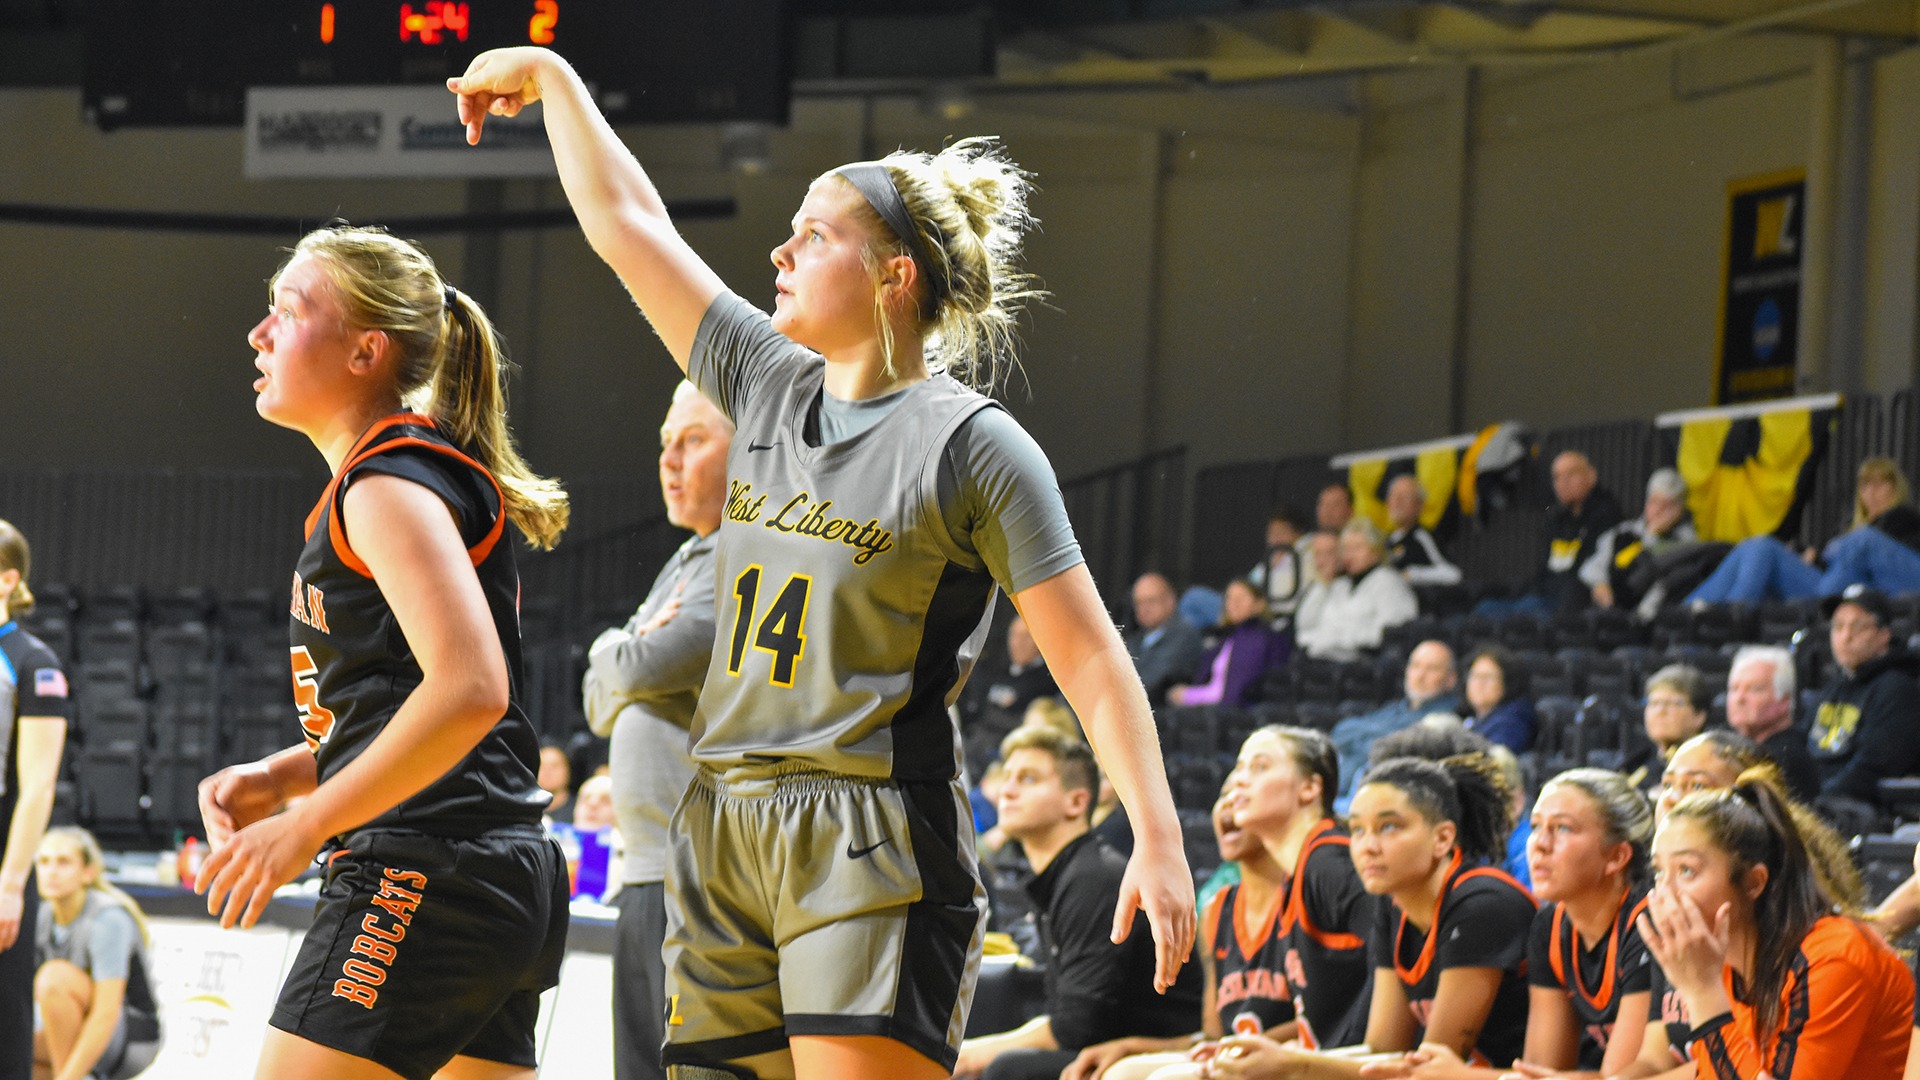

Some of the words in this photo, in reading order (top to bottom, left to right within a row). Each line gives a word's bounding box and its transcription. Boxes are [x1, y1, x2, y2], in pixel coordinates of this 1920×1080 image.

[529, 0, 559, 44] 2
[722, 478, 768, 523] West
[764, 491, 894, 566] Liberty
[726, 563, 813, 689] 14
[332, 867, 427, 1009] BOBCATS
